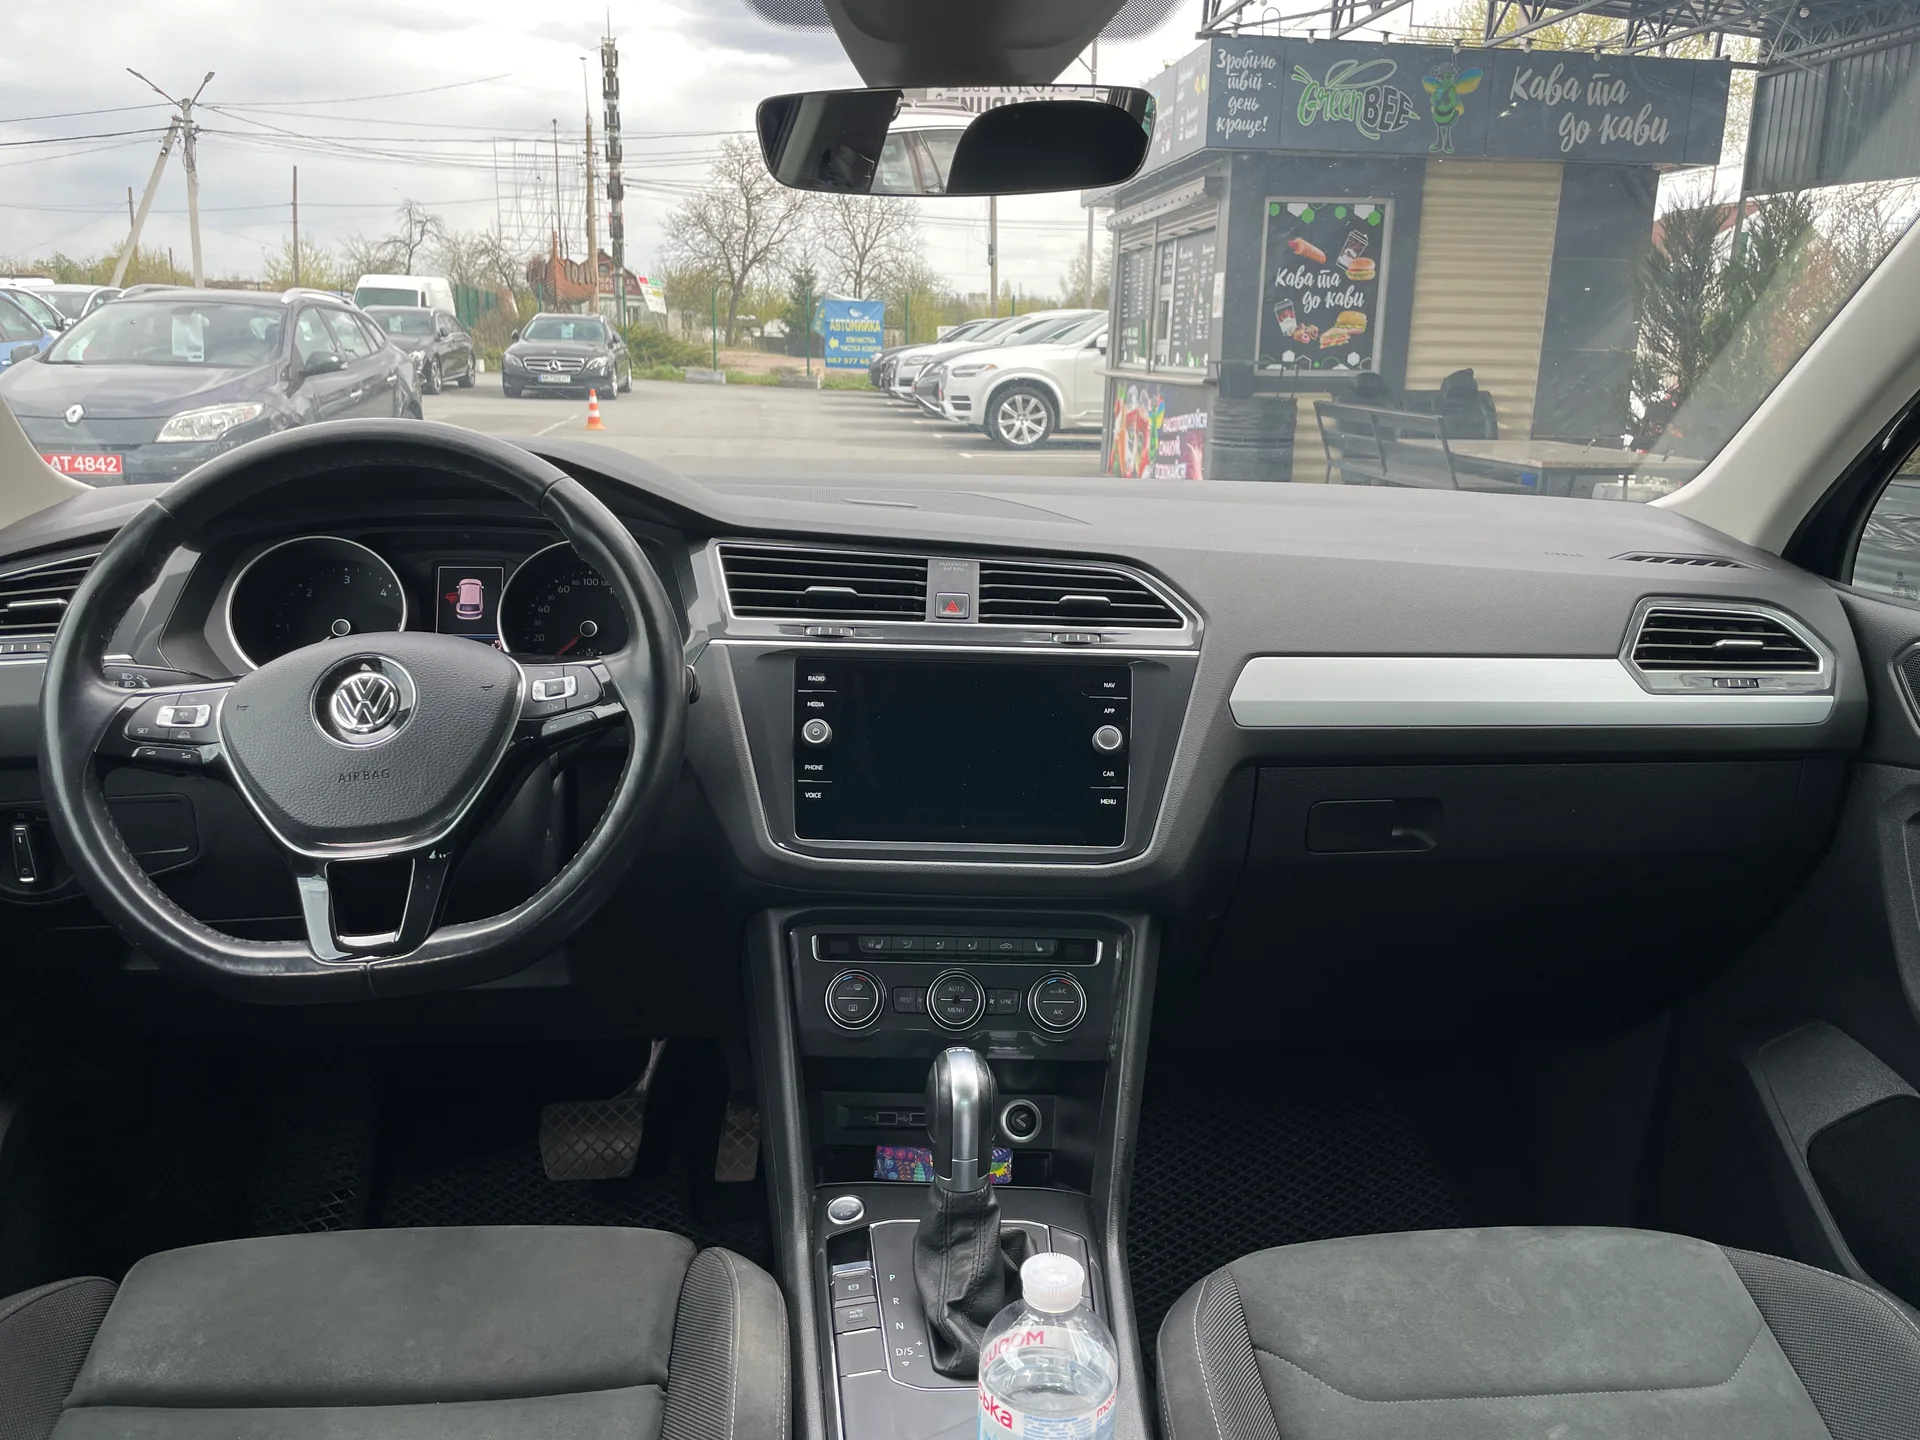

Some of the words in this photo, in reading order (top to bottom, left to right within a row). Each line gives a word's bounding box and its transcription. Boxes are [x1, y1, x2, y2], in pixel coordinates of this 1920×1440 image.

[1216, 48, 1277, 75] Зробимо
[1227, 69, 1263, 91] твій
[1510, 62, 1582, 106] Кава
[1587, 73, 1629, 106] та
[1228, 95, 1260, 115] день
[1216, 116, 1268, 140] краще!
[1558, 112, 1592, 153] до
[1598, 103, 1670, 146] кави
[1275, 265, 1315, 289] Кава
[1317, 269, 1341, 288] та
[1302, 290, 1321, 313] до
[1325, 285, 1365, 309] кави
[74, 457, 117, 472] 4842
[344, 576, 351, 584] 3
[557, 585, 570, 594] 60
[582, 578, 598, 586] 100
[306, 589, 312, 597] 2
[380, 589, 387, 597] 4
[537, 605, 550, 613] 40
[533, 633, 545, 642] 20
[338, 768, 390, 783] AIRBAG
[889, 1274, 896, 1282] P
[893, 1297, 900, 1305] R
[895, 1322, 904, 1330] N
[895, 1347, 914, 1356] D/S
